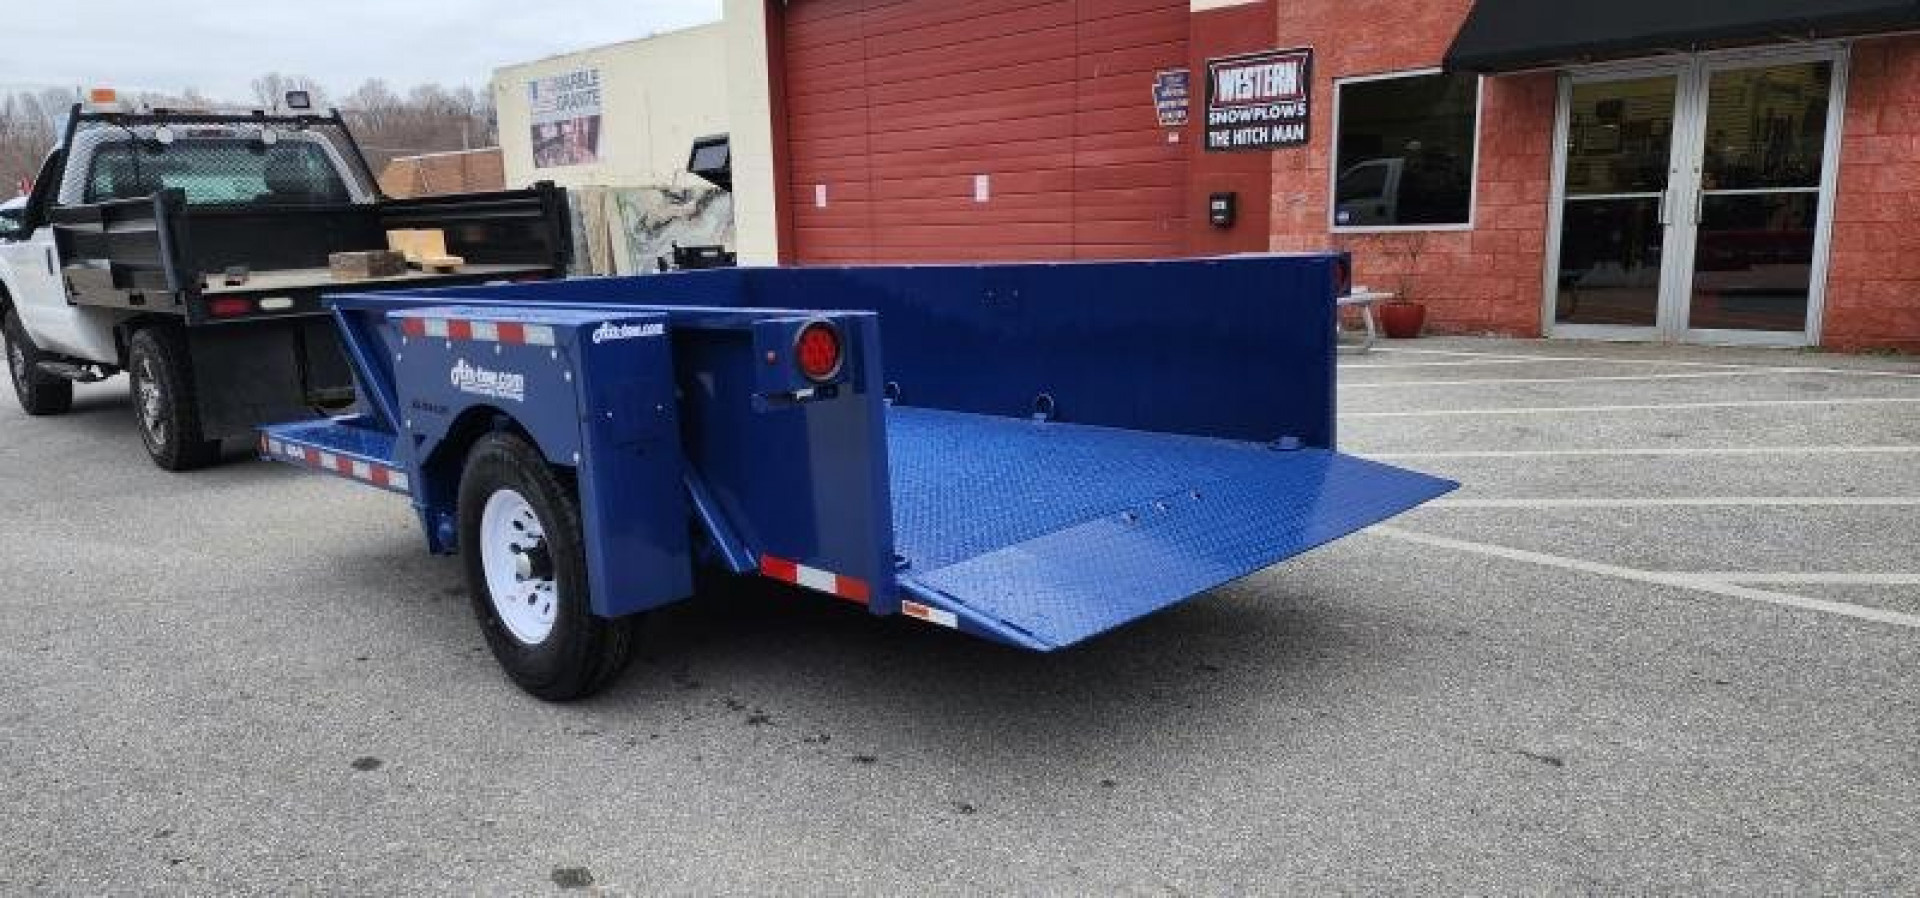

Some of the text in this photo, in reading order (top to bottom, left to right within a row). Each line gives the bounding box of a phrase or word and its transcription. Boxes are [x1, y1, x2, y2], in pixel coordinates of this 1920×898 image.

[1218, 61, 1297, 102] WESTERN
[556, 89, 600, 110] GRANITE
[1209, 102, 1306, 126] SNOWPLOWS
[1209, 123, 1304, 147] THE HITCH MAN
